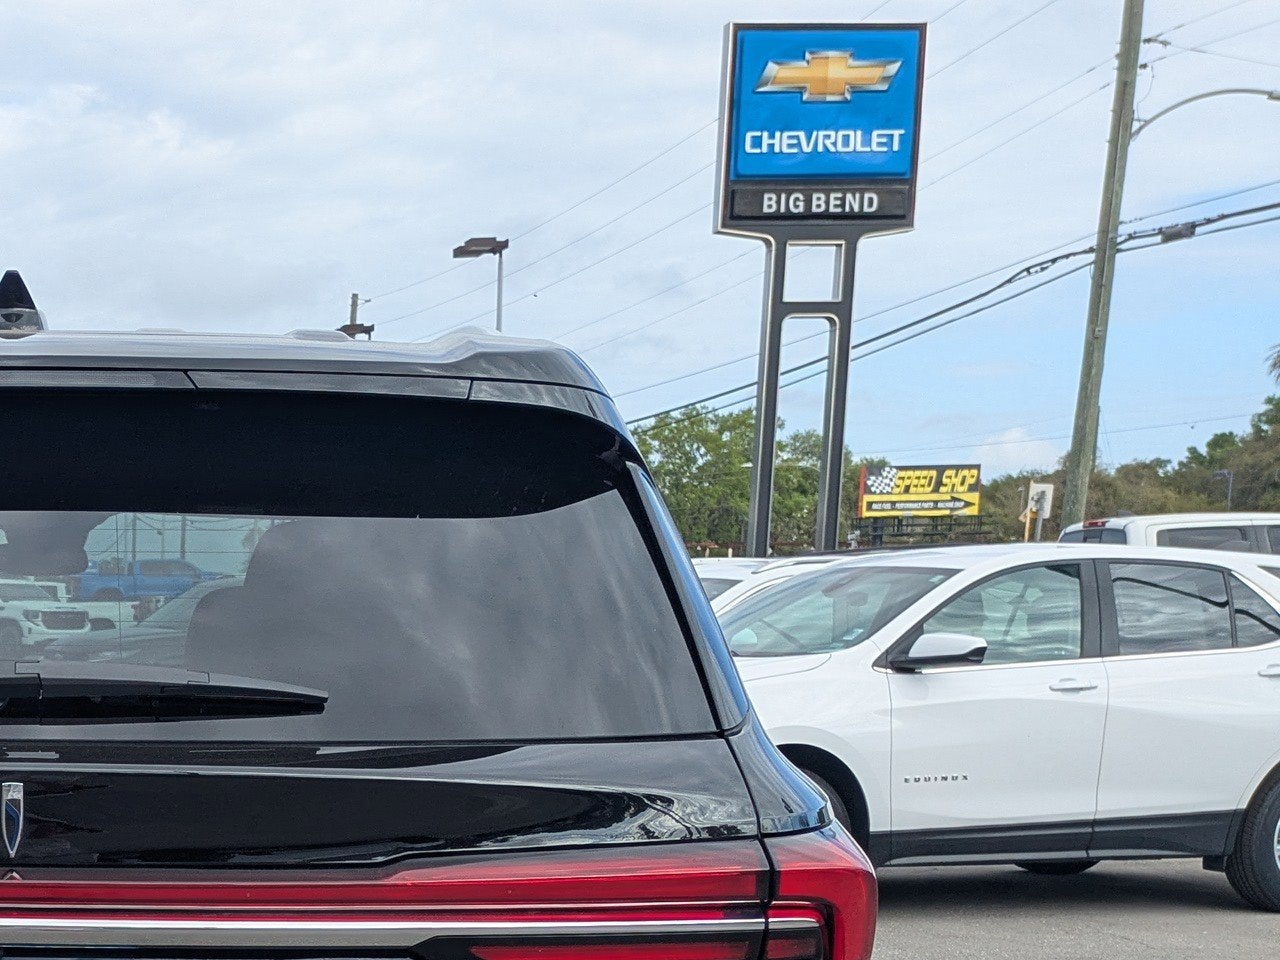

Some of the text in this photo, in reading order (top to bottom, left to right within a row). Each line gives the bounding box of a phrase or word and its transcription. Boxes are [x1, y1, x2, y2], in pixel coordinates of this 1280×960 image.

[744, 129, 906, 154] CHEVROLET
[762, 192, 879, 214] BIG BEND
[892, 468, 978, 495] SPEED SHOP
[904, 775, 968, 783] EQUINOX
